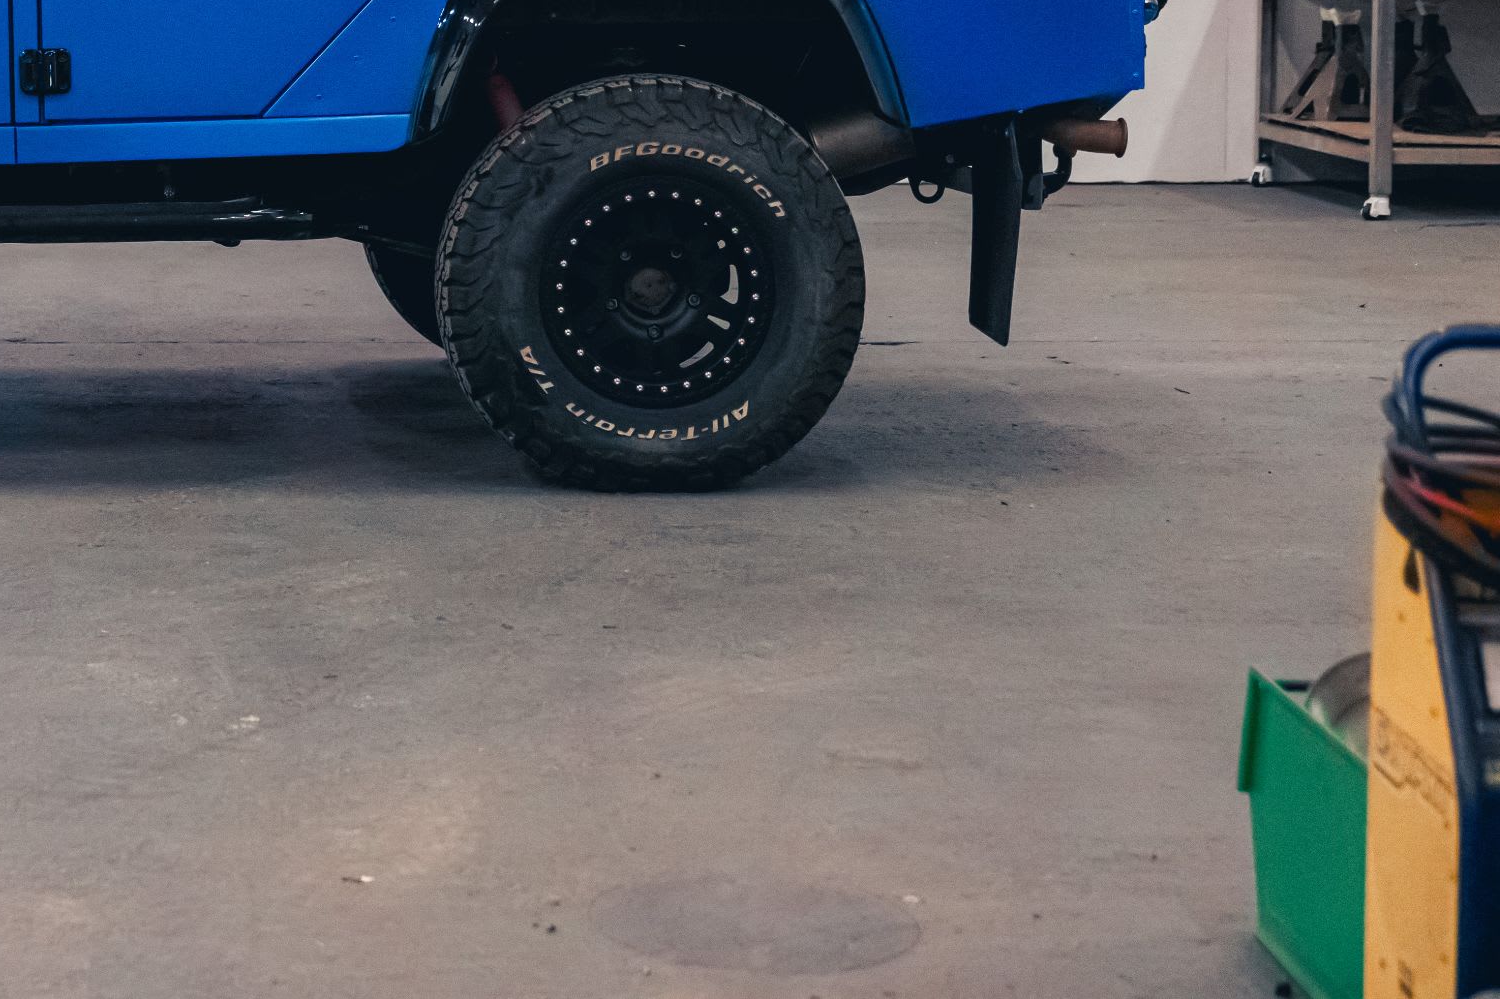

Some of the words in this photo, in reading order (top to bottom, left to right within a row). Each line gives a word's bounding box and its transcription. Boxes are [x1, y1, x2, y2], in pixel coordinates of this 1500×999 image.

[590, 141, 786, 218] BFGoodrich
[520, 345, 555, 394] T/A
[565, 400, 749, 441] All-Terrain
